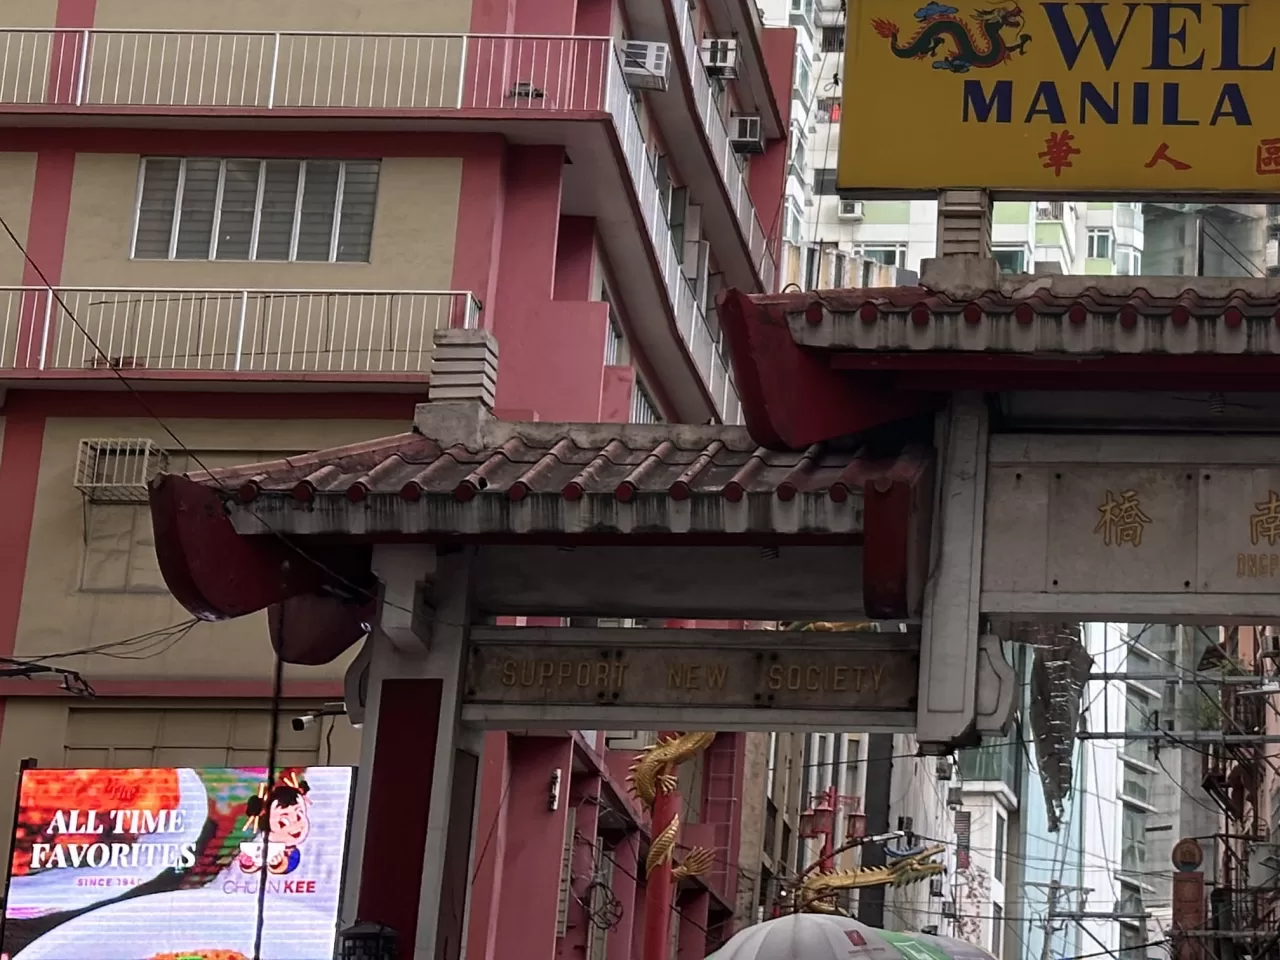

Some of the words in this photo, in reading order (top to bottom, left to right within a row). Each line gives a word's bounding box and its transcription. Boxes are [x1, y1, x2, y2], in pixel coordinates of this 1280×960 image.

[962, 80, 1253, 126] MANILA
[502, 660, 630, 689] SUPPORT
[667, 663, 730, 691] NEW
[768, 664, 885, 692] SOCIETY
[47, 809, 104, 834] ALL
[110, 808, 187, 834] TIME
[30, 842, 197, 869] FAVORITES
[76, 877, 113, 888] SINCE
[222, 880, 281, 894] CHUN
[283, 880, 317, 894] KEE
